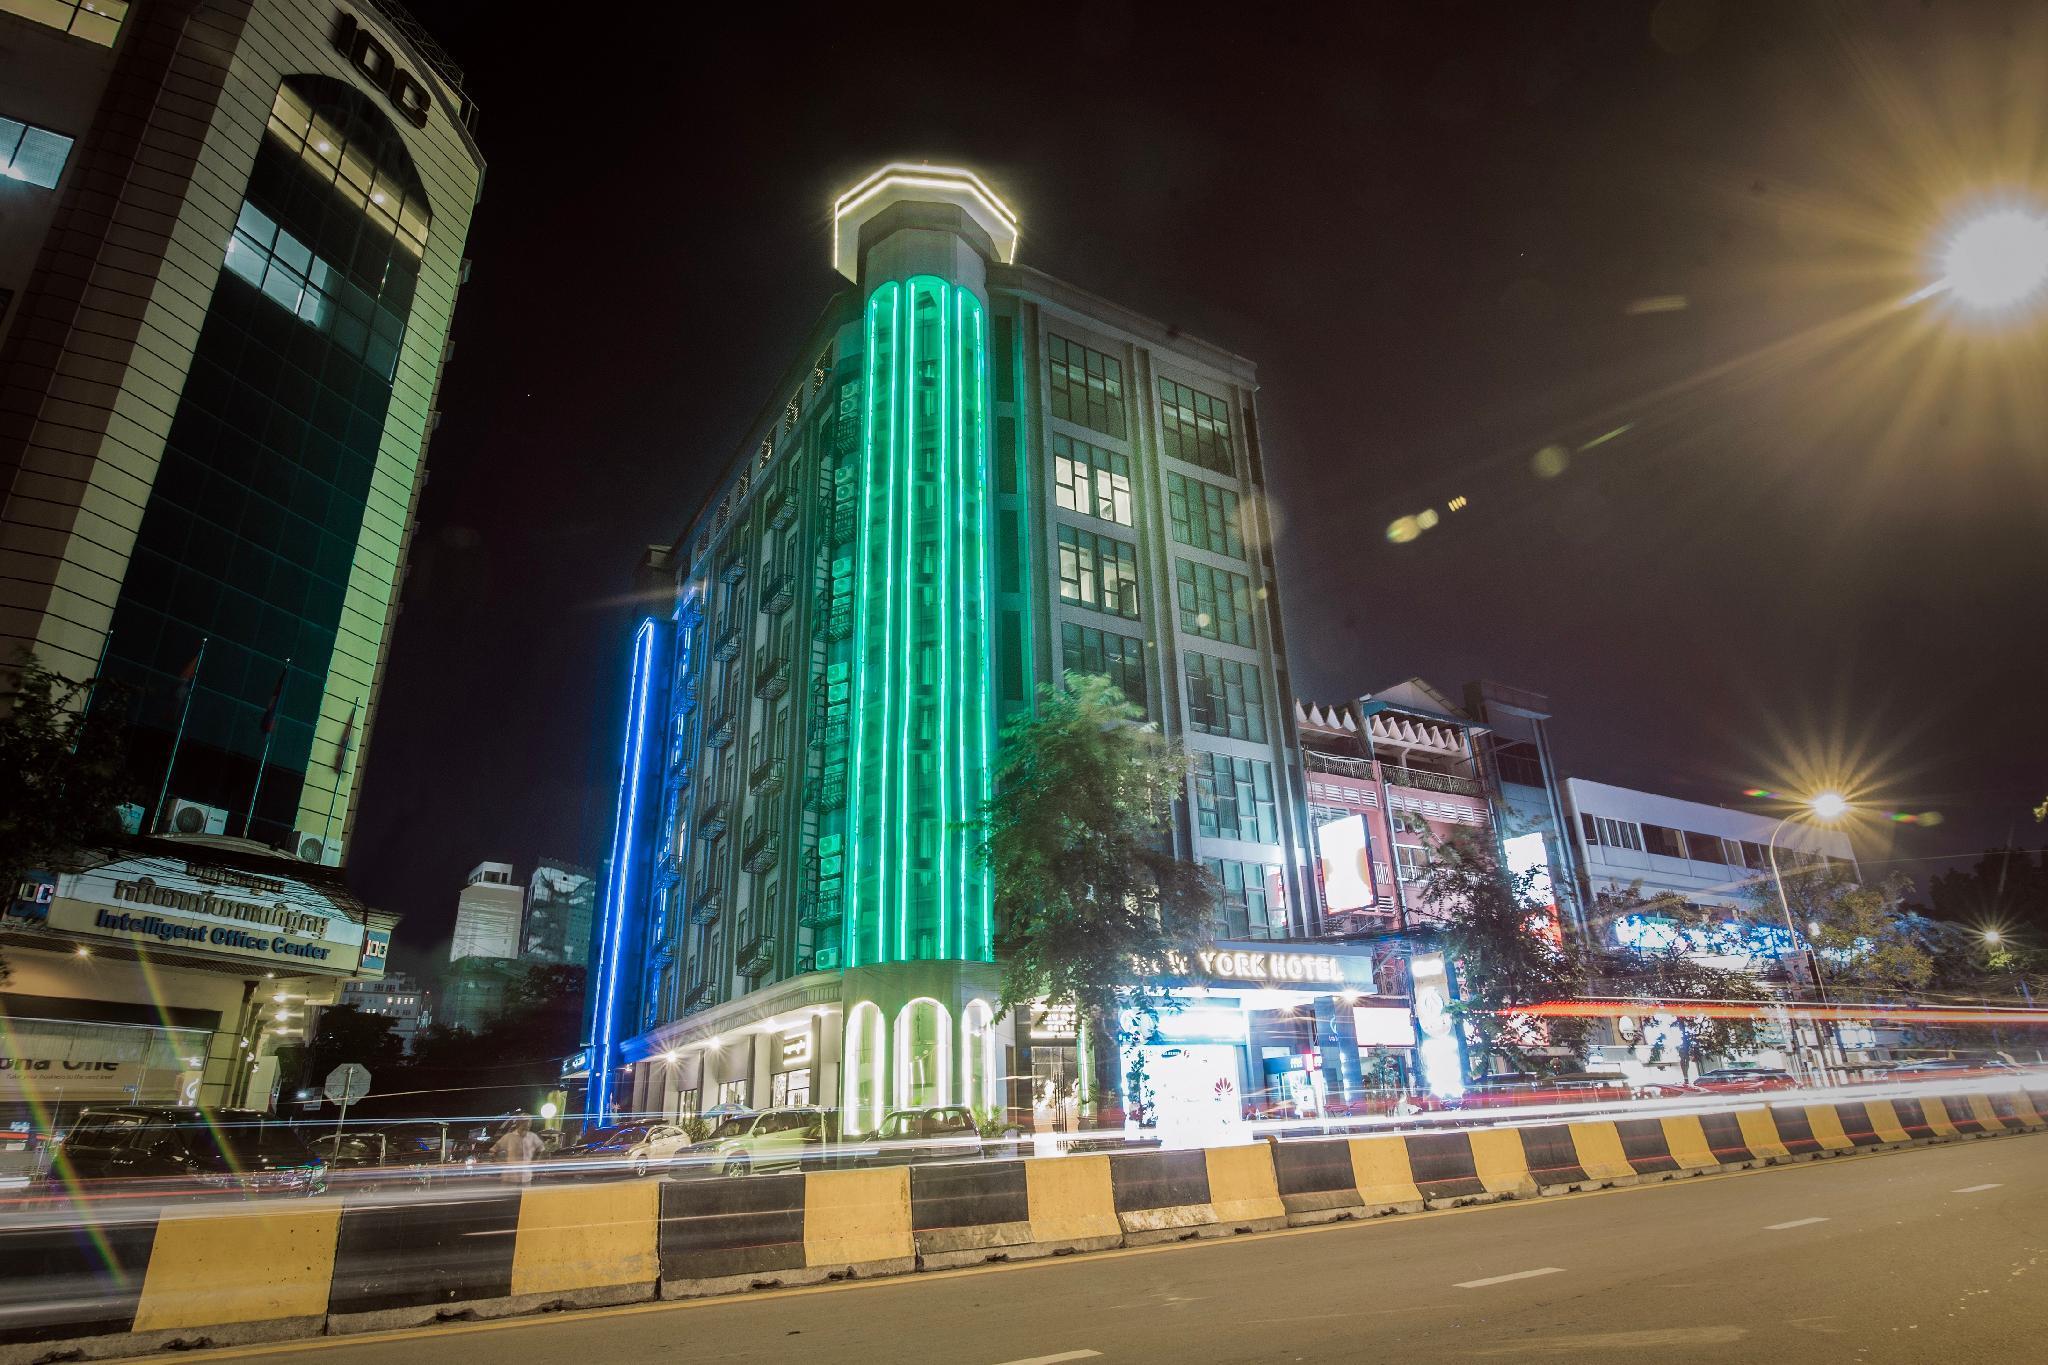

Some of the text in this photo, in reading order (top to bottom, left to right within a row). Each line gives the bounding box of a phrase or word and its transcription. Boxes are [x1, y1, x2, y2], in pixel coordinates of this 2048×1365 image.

[96, 909, 331, 960] Intelligent Office Center
[1199, 951, 1267, 978] YORK
[1269, 953, 1343, 982] HOTEL
